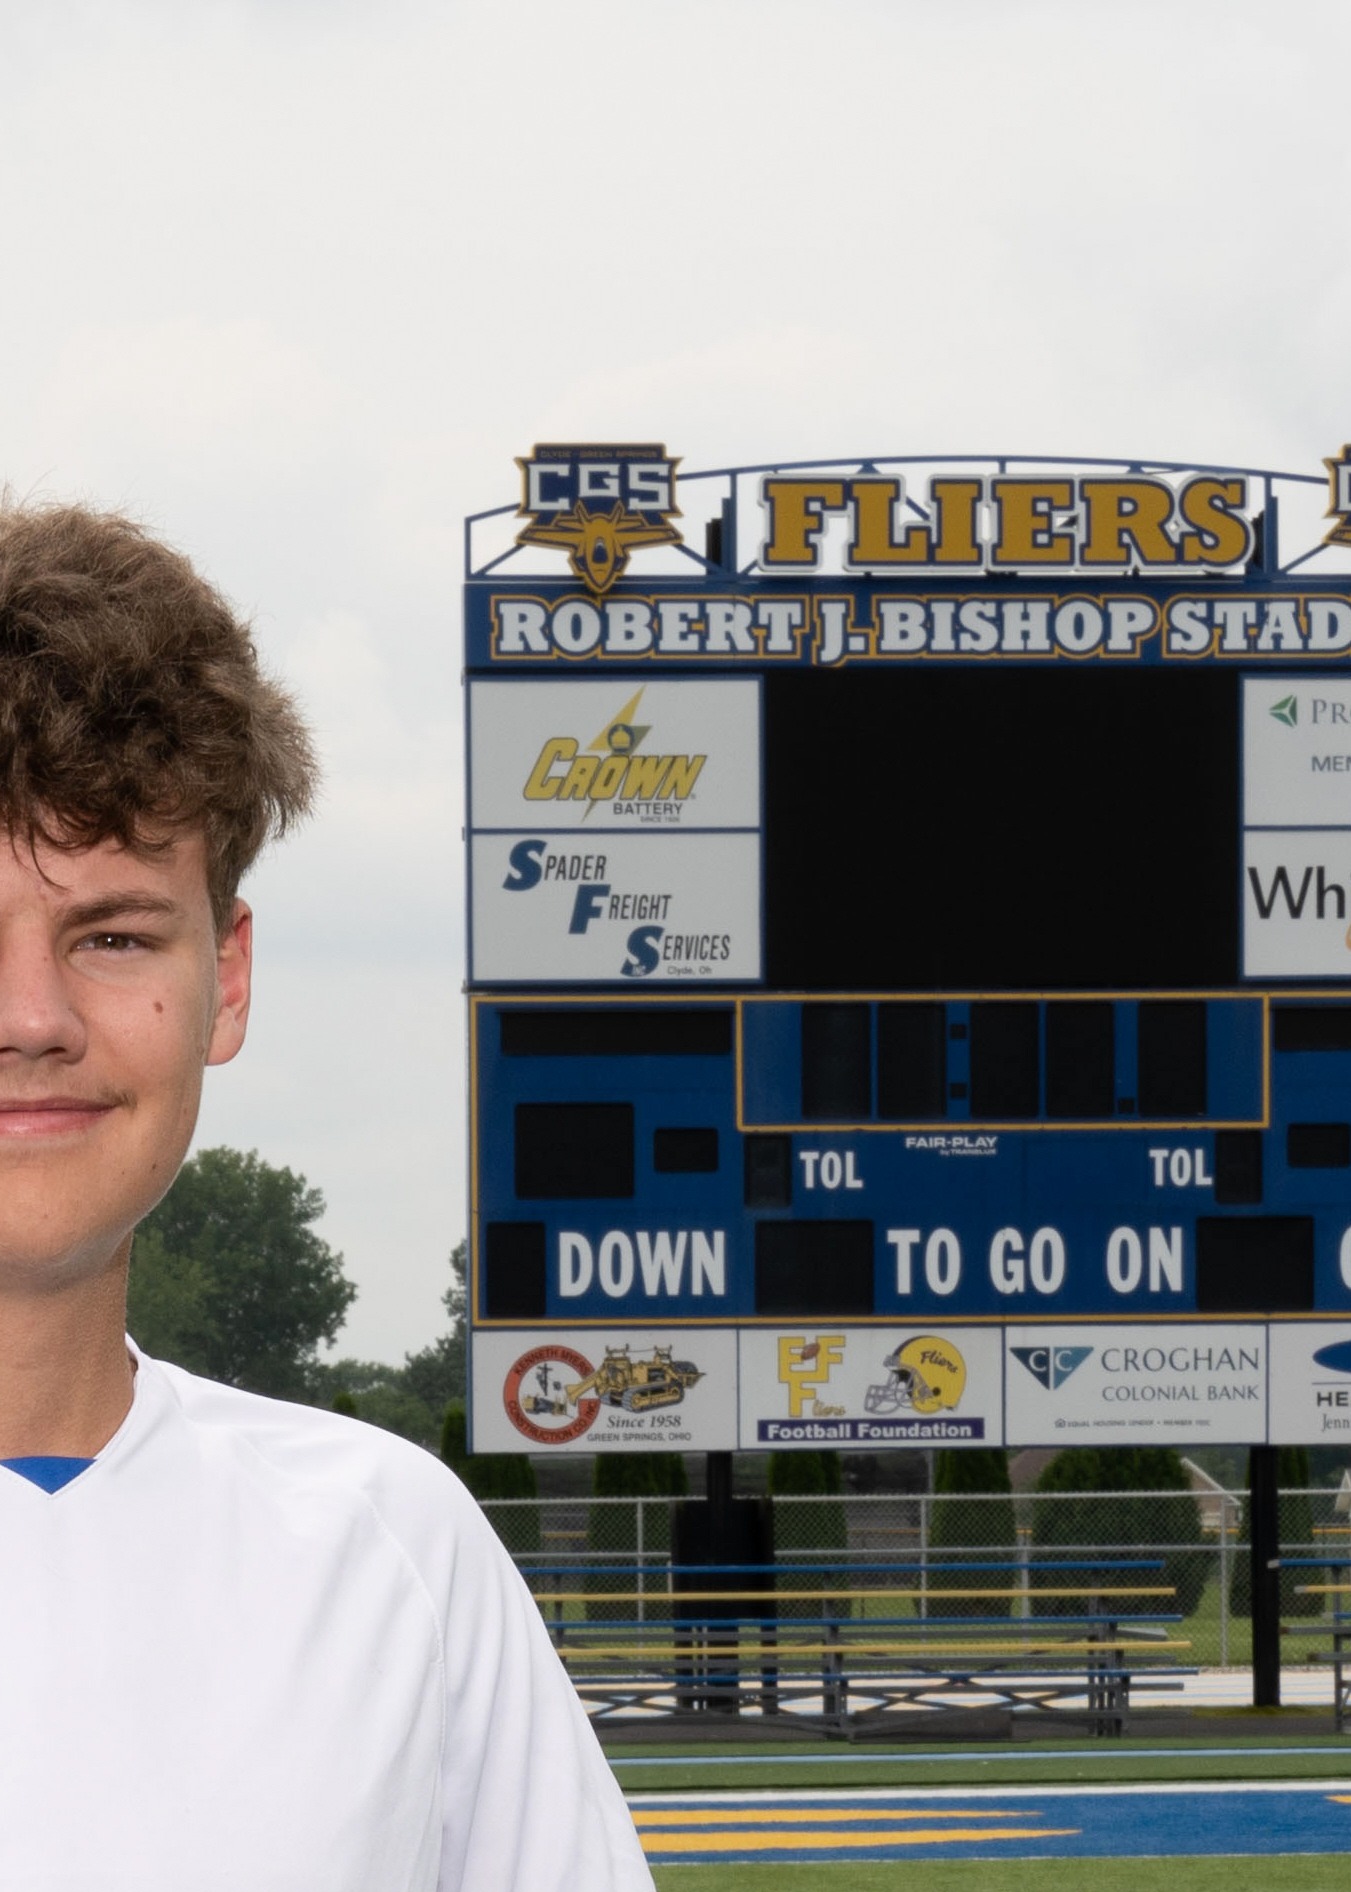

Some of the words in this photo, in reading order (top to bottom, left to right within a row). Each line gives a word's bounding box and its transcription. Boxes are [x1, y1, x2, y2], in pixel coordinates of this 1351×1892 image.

[528, 463, 670, 511] CGS
[763, 475, 1253, 570] FLIERS
[498, 600, 804, 653] ROBERT
[817, 601, 871, 663] J.
[879, 600, 1155, 652] BISHOP
[1169, 600, 1351, 652] STAD
[1312, 698, 1351, 725] PR
[522, 736, 708, 801] CROWN
[1311, 755, 1351, 773] ME
[612, 802, 683, 815] BATTERY
[501, 839, 607, 891] SPADER
[568, 884, 672, 935] FREIGHT
[619, 925, 731, 977] SERVICES
[905, 1136, 997, 1148] FAIR-PLAY
[799, 1151, 864, 1189] TOL
[1148, 1148, 1213, 1187] TOL
[559, 1230, 725, 1297] DOWN
[887, 1228, 962, 1295] TO
[989, 1227, 1065, 1294] GO
[1106, 1226, 1182, 1293] ON
[1101, 1347, 1260, 1372] CROGHAN
[1102, 1385, 1199, 1401] COLONIAL
[1207, 1384, 1260, 1400] BANK
[587, 1432, 620, 1442] GREEN
[668, 1432, 692, 1441] OHIO
[607, 1414, 645, 1429] Since
[650, 1414, 682, 1428] 1958
[767, 1423, 851, 1439] Football
[857, 1422, 972, 1438] Foundation
